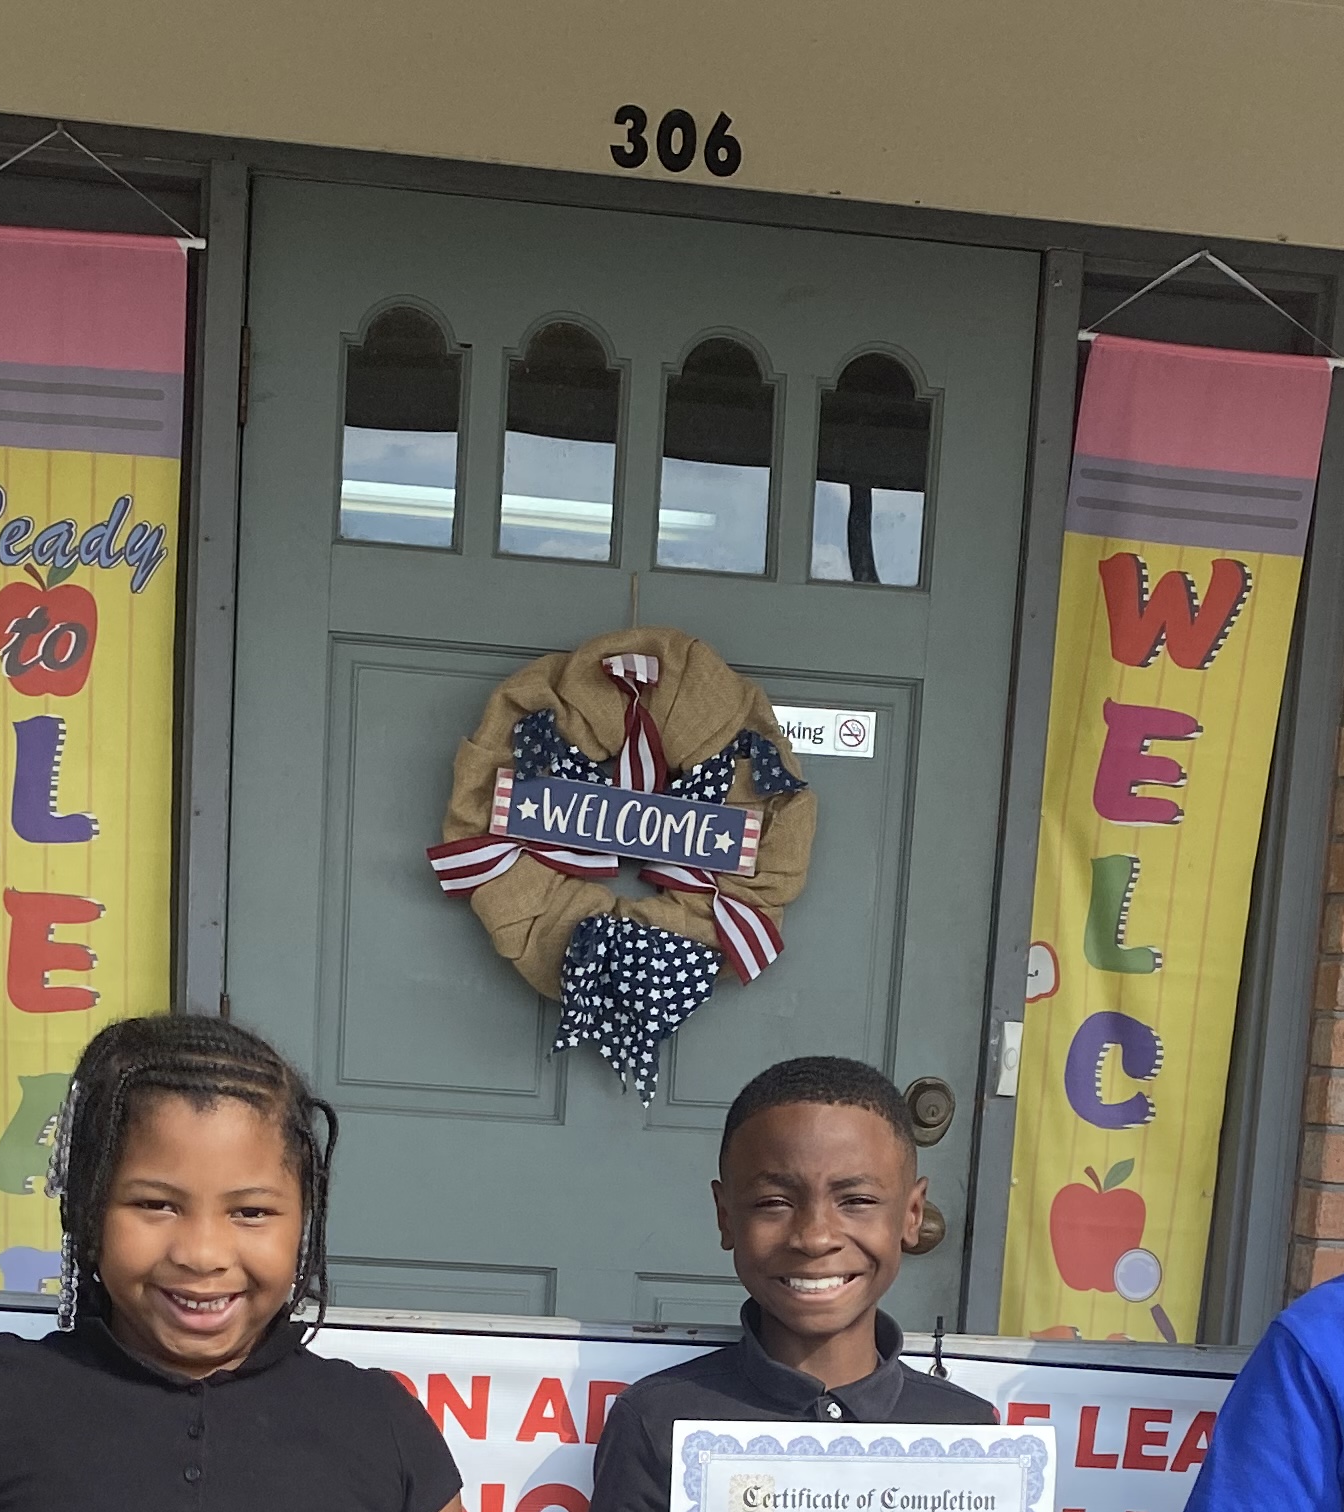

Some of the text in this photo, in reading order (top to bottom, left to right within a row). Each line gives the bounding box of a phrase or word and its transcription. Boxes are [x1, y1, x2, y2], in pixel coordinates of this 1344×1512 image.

[610, 104, 742, 178] 306
[542, 787, 719, 857] WELCOME
[742, 1485, 850, 1512] Certificate
[856, 1488, 876, 1511] of
